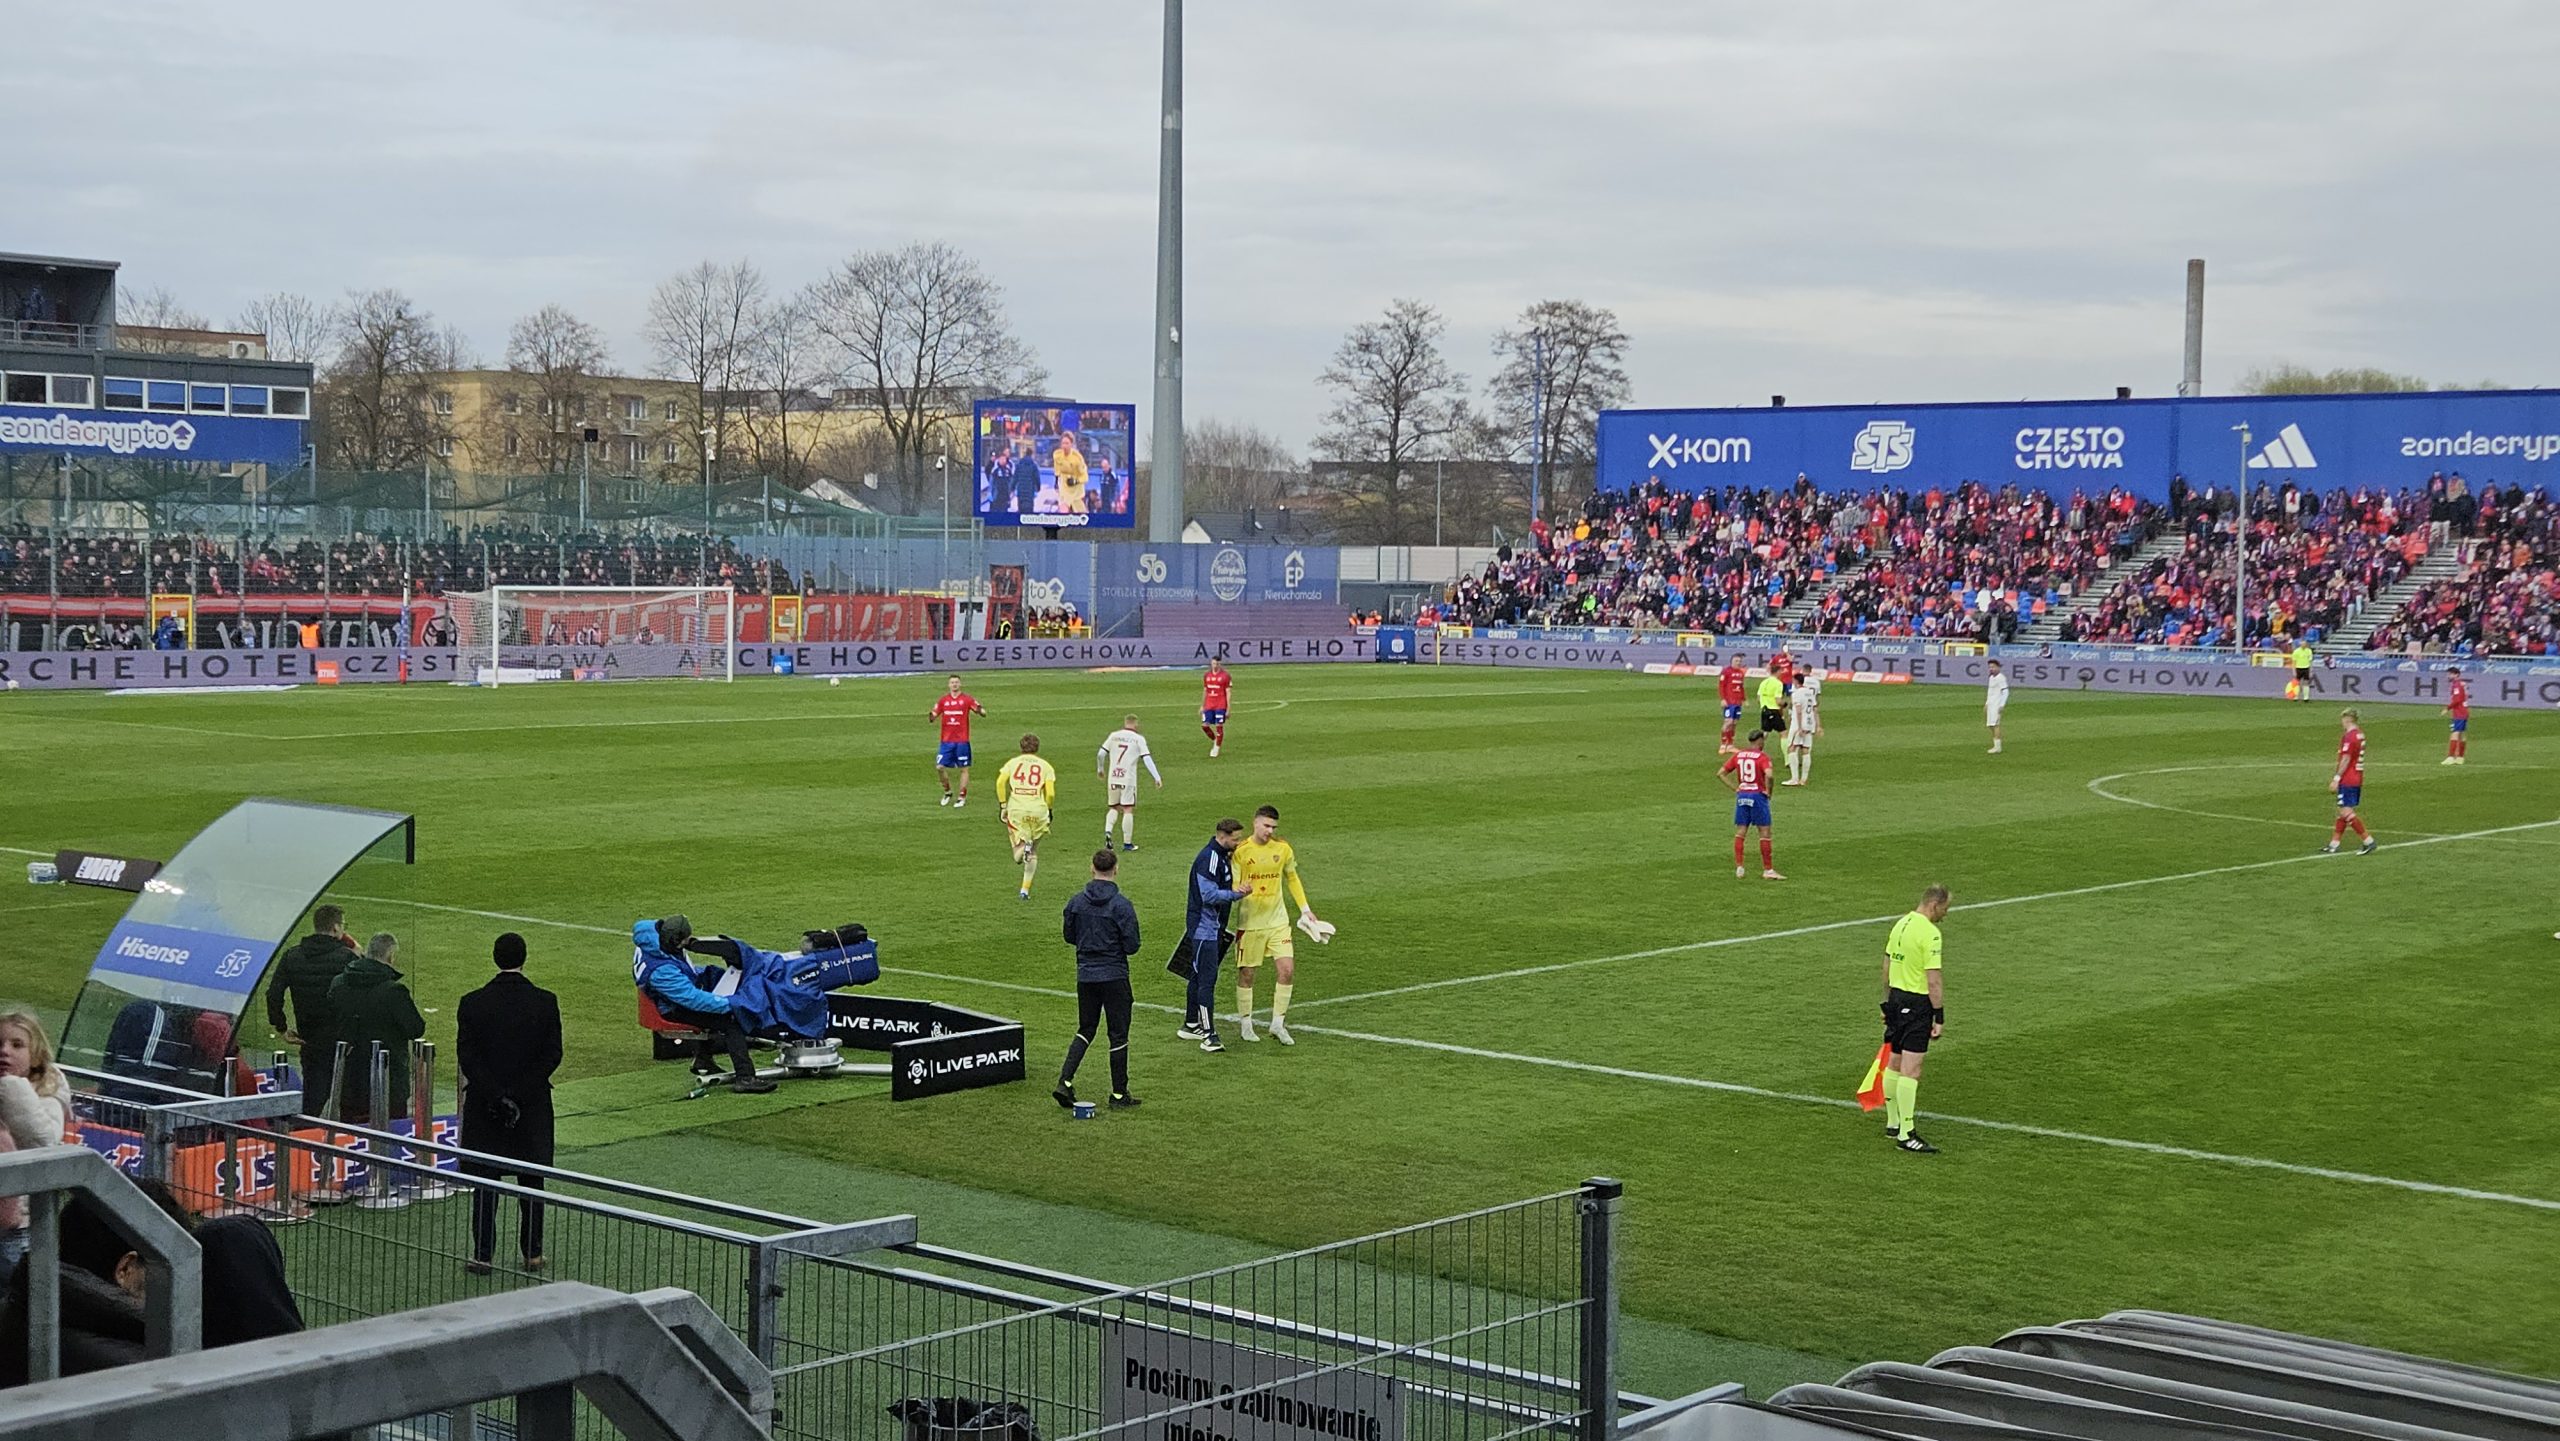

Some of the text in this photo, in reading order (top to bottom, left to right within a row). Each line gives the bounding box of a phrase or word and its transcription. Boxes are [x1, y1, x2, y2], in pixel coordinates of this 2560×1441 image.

[2, 418, 169, 450] zondacrypto
[2015, 427, 2125, 455] CZĘSTO
[2401, 430, 2560, 461] zondacryp
[1851, 421, 1915, 473] STS
[1285, 566, 1304, 588] EP
[1264, 589, 1322, 601] Nieruchomości
[678, 644, 1152, 669] ARCHE HOTEL CZĘSTOCHOWA
[1194, 639, 1293, 659] ARCHE
[1421, 642, 1624, 663] CZĘSTOCHOWA
[164, 654, 317, 679] HOTEL
[1823, 655, 1950, 677] HOTEL
[1966, 663, 2234, 688] CĘSTOCHOWA
[1117, 745, 1128, 765] 7
[1013, 763, 1041, 786] 48
[1737, 759, 1756, 782] 19
[116, 936, 190, 965] Hisense
[833, 958, 851, 967] LIVE
[215, 949, 252, 978] STS
[832, 1014, 920, 1034] LIVE PARK
[936, 1048, 1020, 1074] LIVE PARK
[215, 1144, 275, 1197] STS
[1126, 1357, 1381, 1441] Prosimy o zajmowanie
